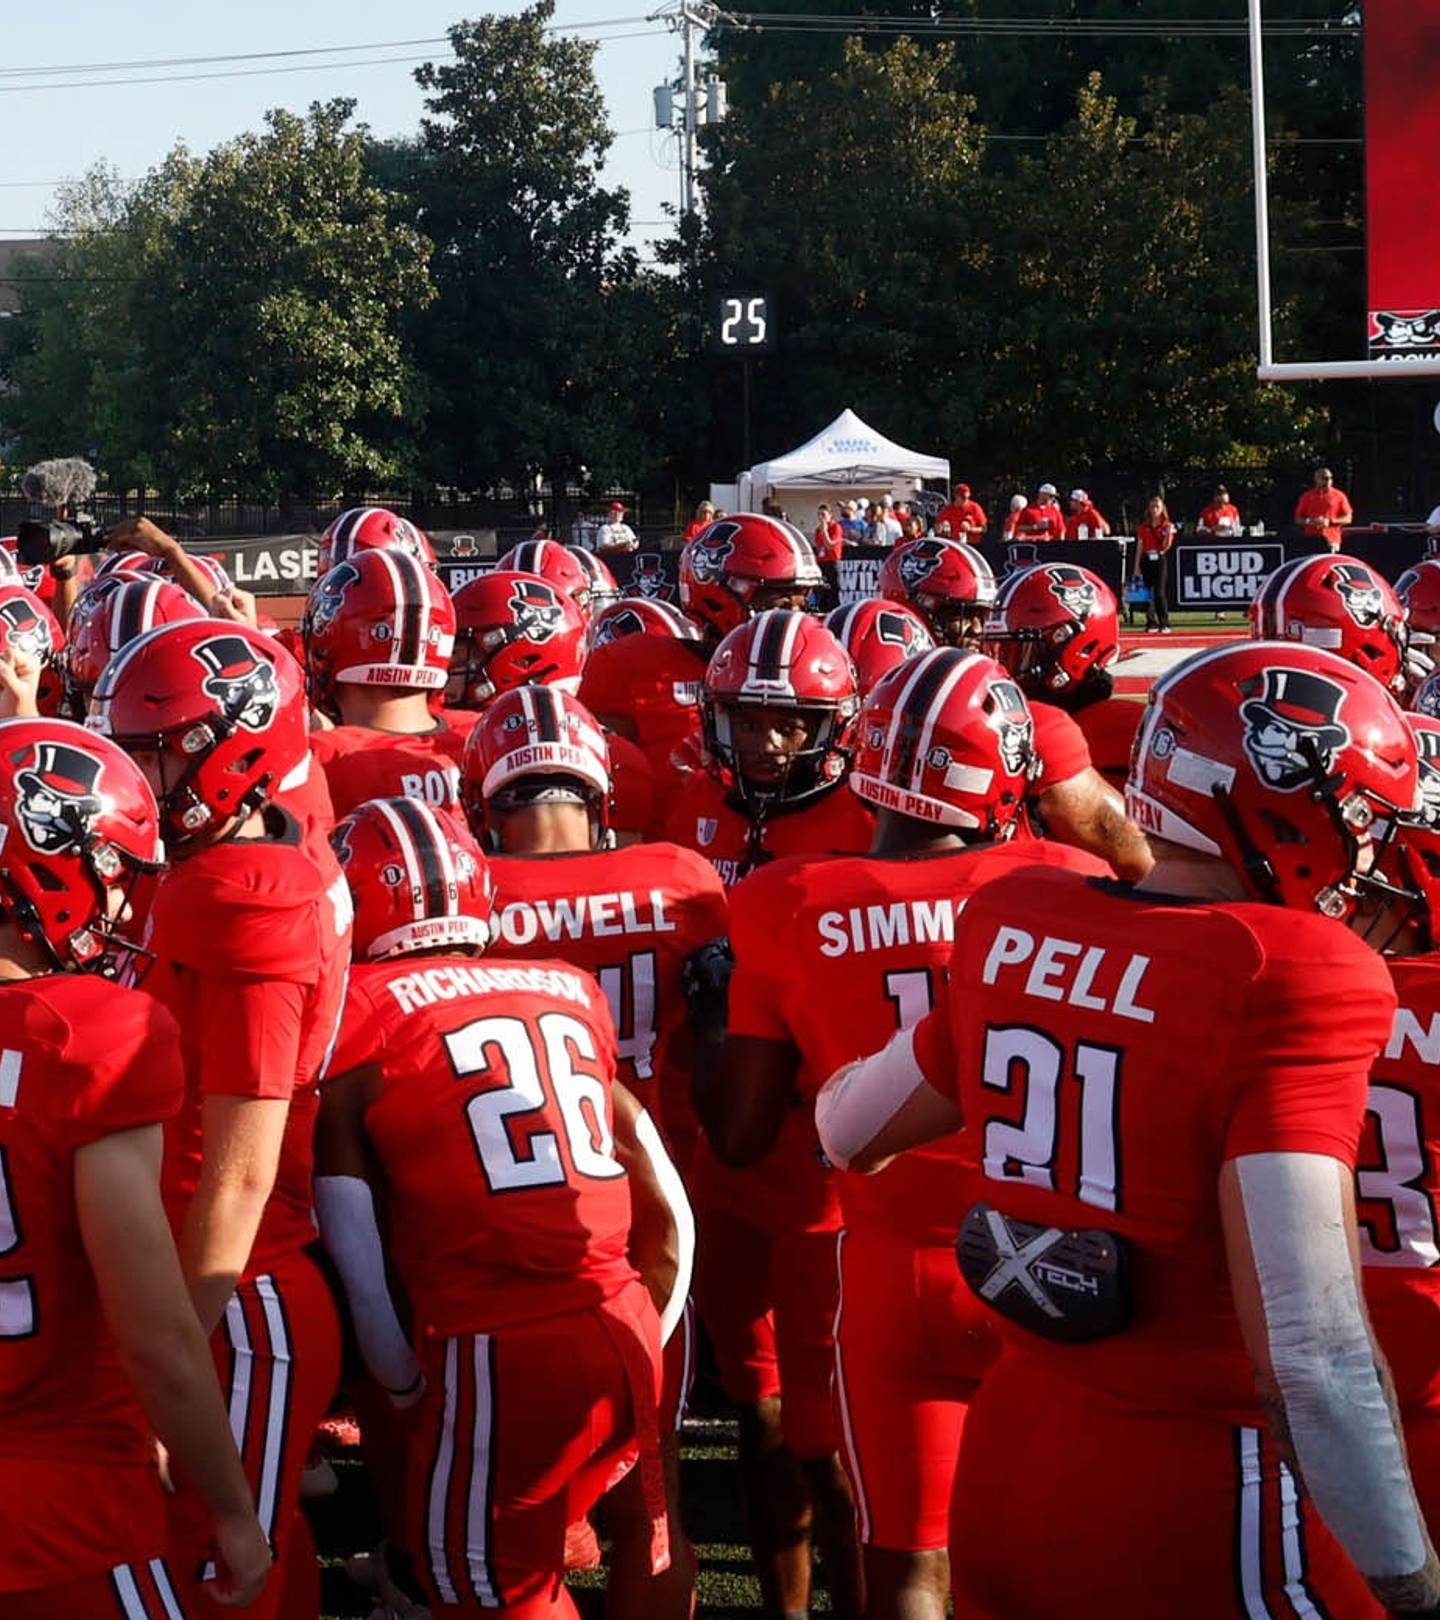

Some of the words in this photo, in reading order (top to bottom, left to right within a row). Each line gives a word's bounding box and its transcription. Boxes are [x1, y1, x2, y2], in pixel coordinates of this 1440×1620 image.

[722, 298, 766, 344] 25
[1197, 552, 1264, 575] BUD
[367, 668, 412, 683] AUSTIN
[507, 746, 554, 772] AUSTIN
[905, 795, 943, 821] PEAY
[411, 922, 444, 938] AUSTIN
[388, 966, 592, 1014] RICHARDSON
[983, 925, 1157, 1023] PELL
[445, 1012, 626, 1191] 26
[983, 1026, 1119, 1213] 21
